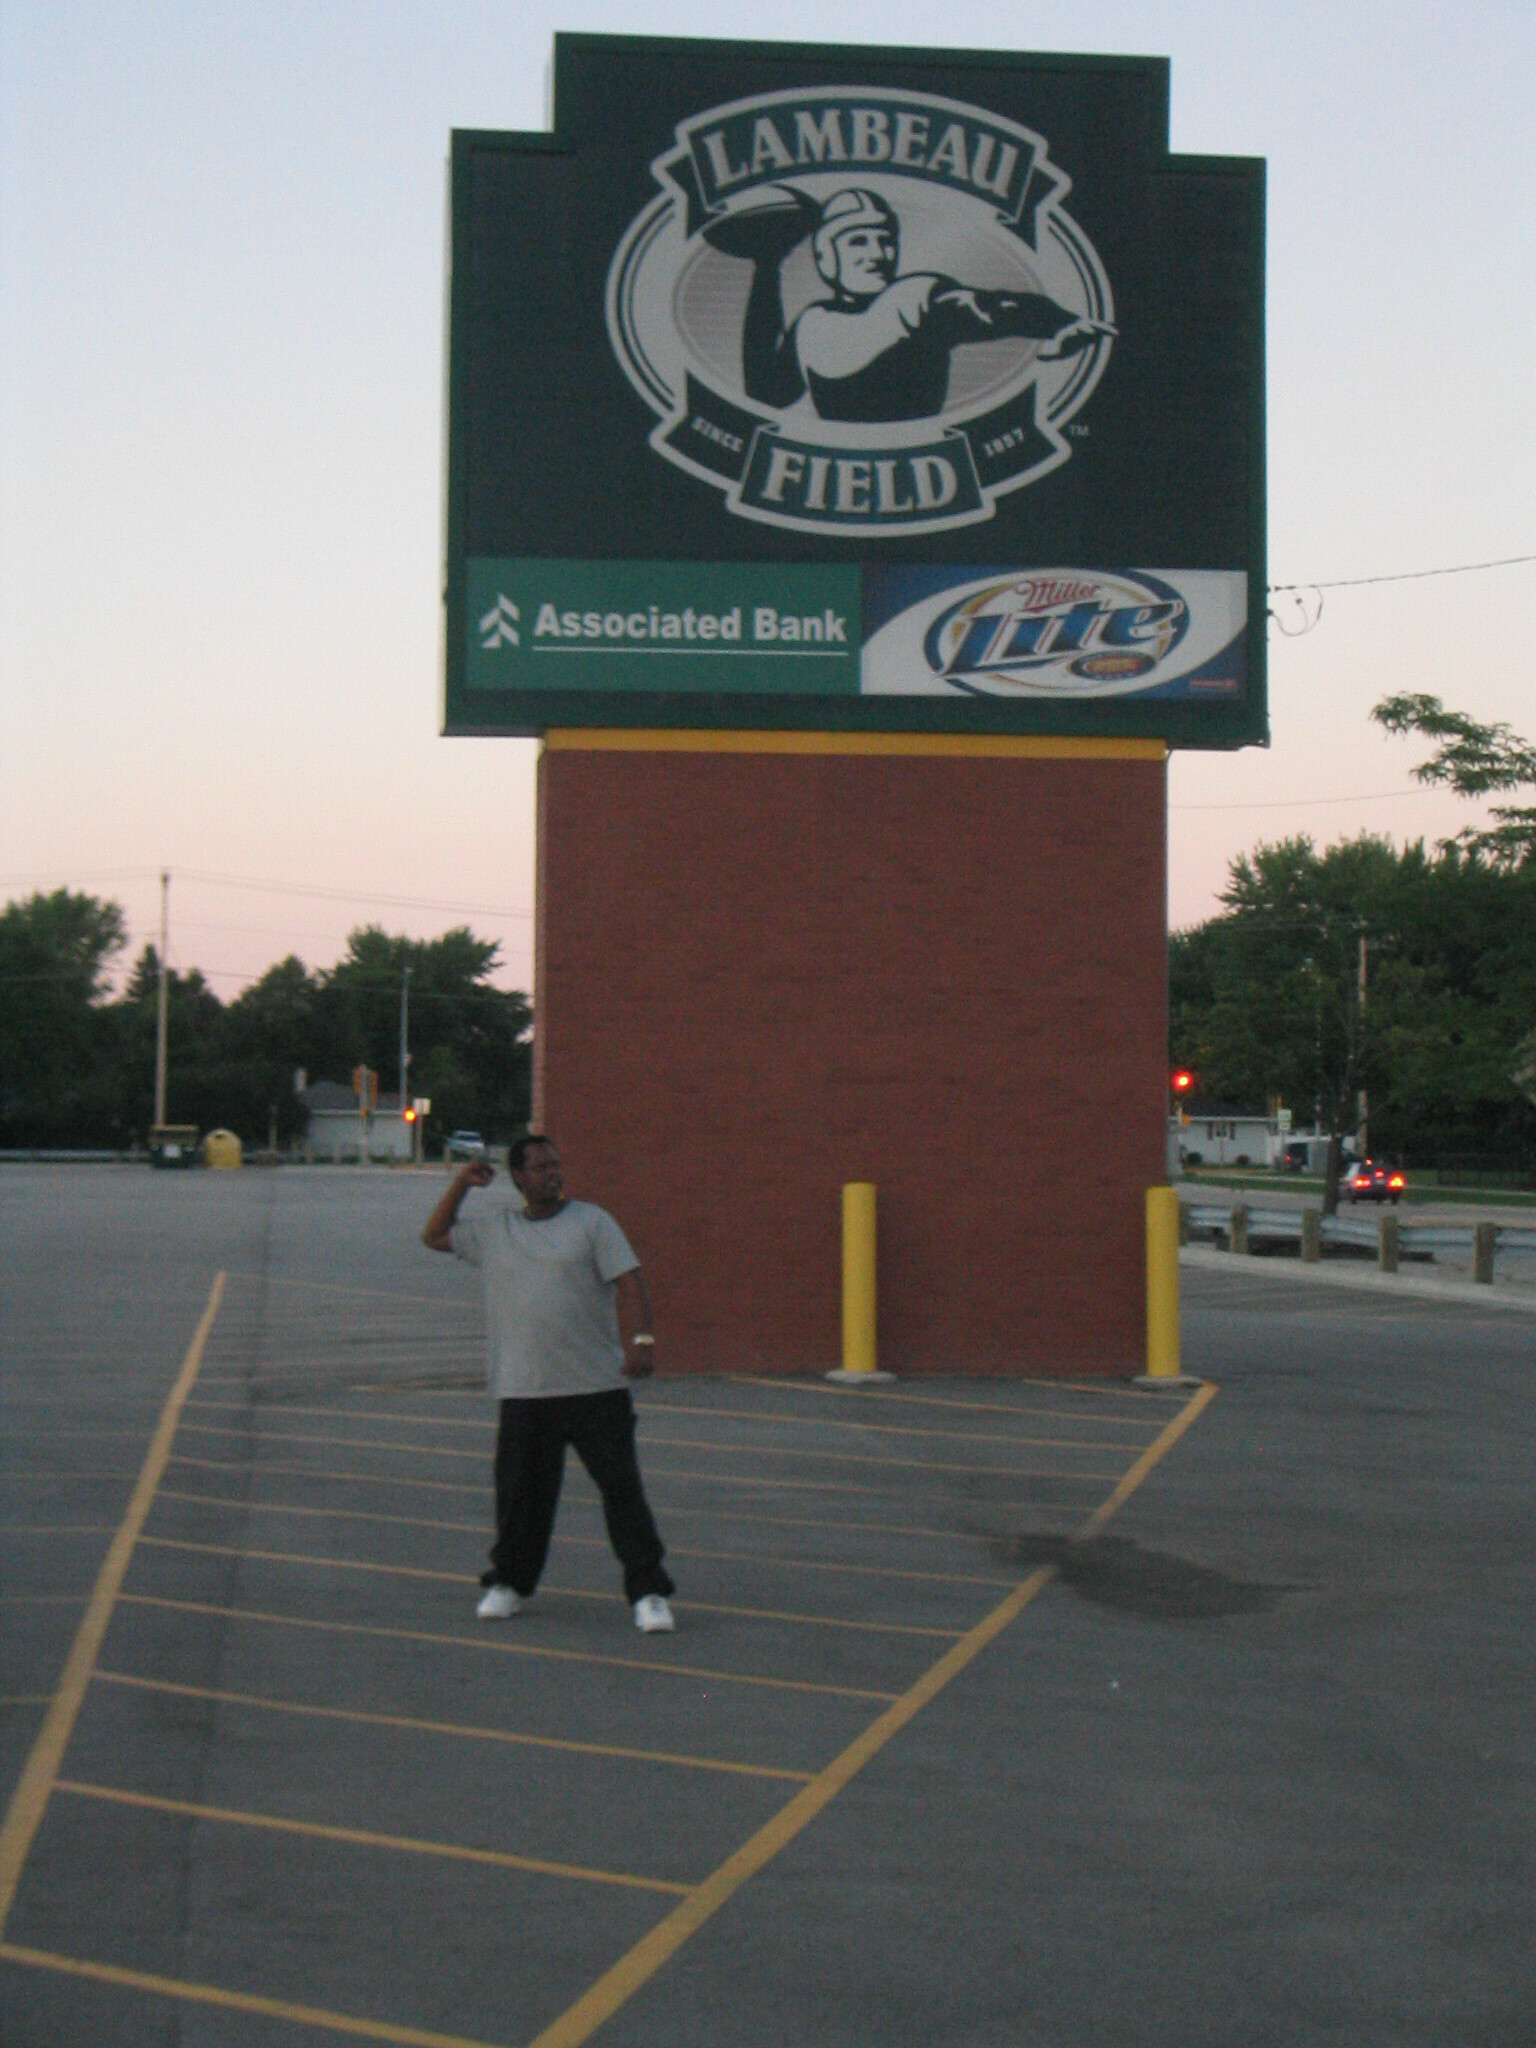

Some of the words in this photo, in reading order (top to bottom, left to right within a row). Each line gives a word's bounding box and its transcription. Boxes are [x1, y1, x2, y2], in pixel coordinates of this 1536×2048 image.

[703, 108, 1018, 199] LAMBEAU
[691, 417, 743, 452] SINCE
[761, 446, 958, 514] FIELD
[1015, 578, 1101, 611] Miller
[534, 603, 742, 641] Associated
[754, 607, 847, 643] Bank
[945, 600, 1182, 675] Lite
